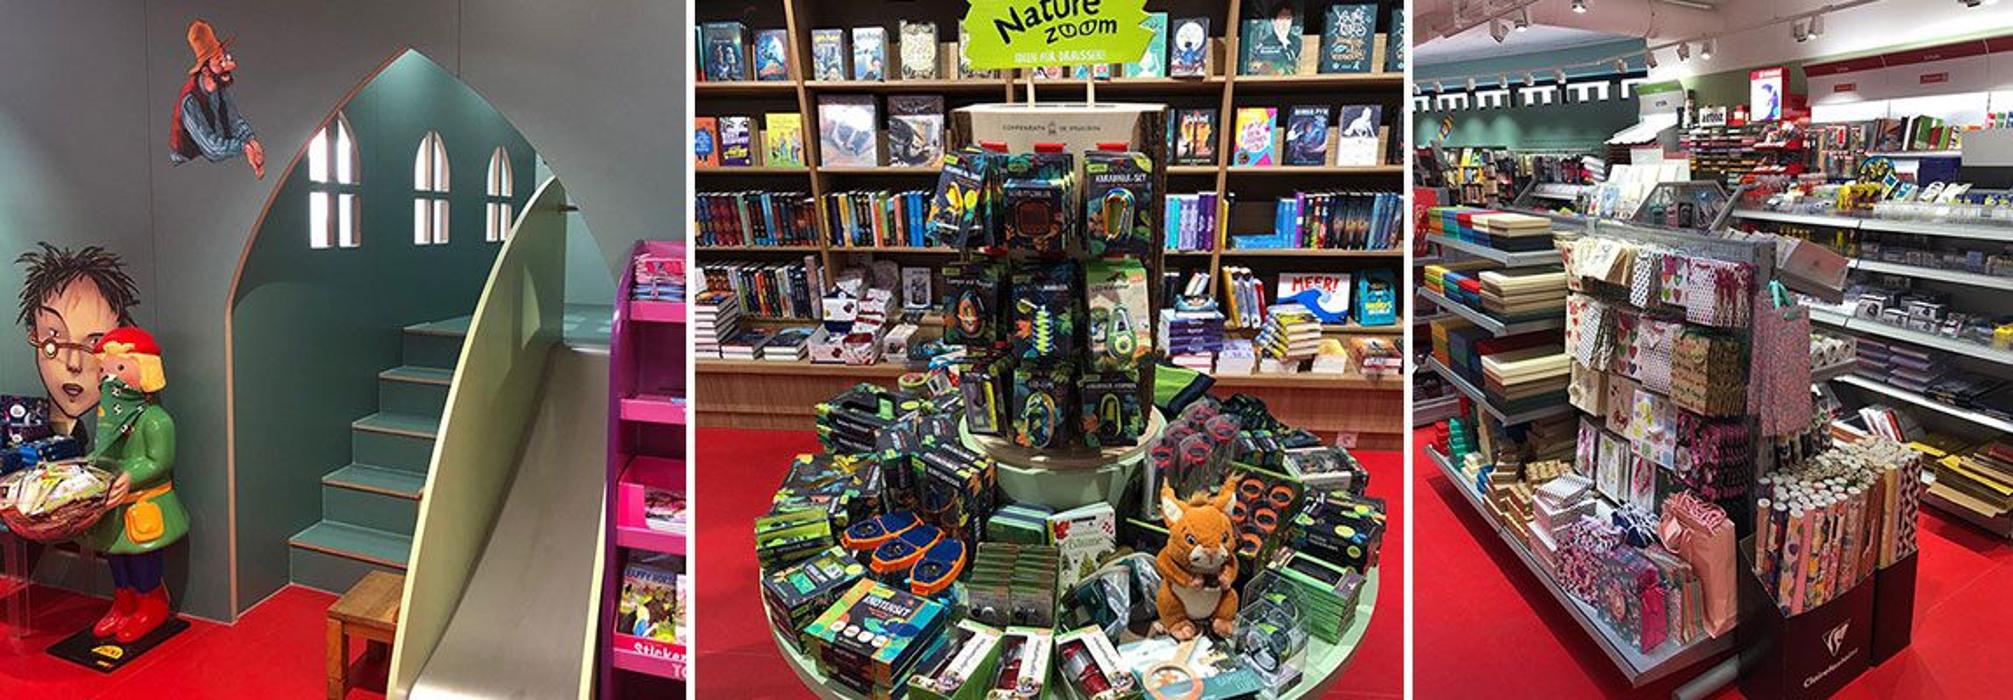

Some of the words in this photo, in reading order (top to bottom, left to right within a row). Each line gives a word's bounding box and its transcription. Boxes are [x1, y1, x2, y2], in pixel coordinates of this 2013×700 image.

[994, 0, 1100, 44] Nature
[1044, 19, 1118, 44] zoom
[1291, 275, 1340, 293] MEER!
